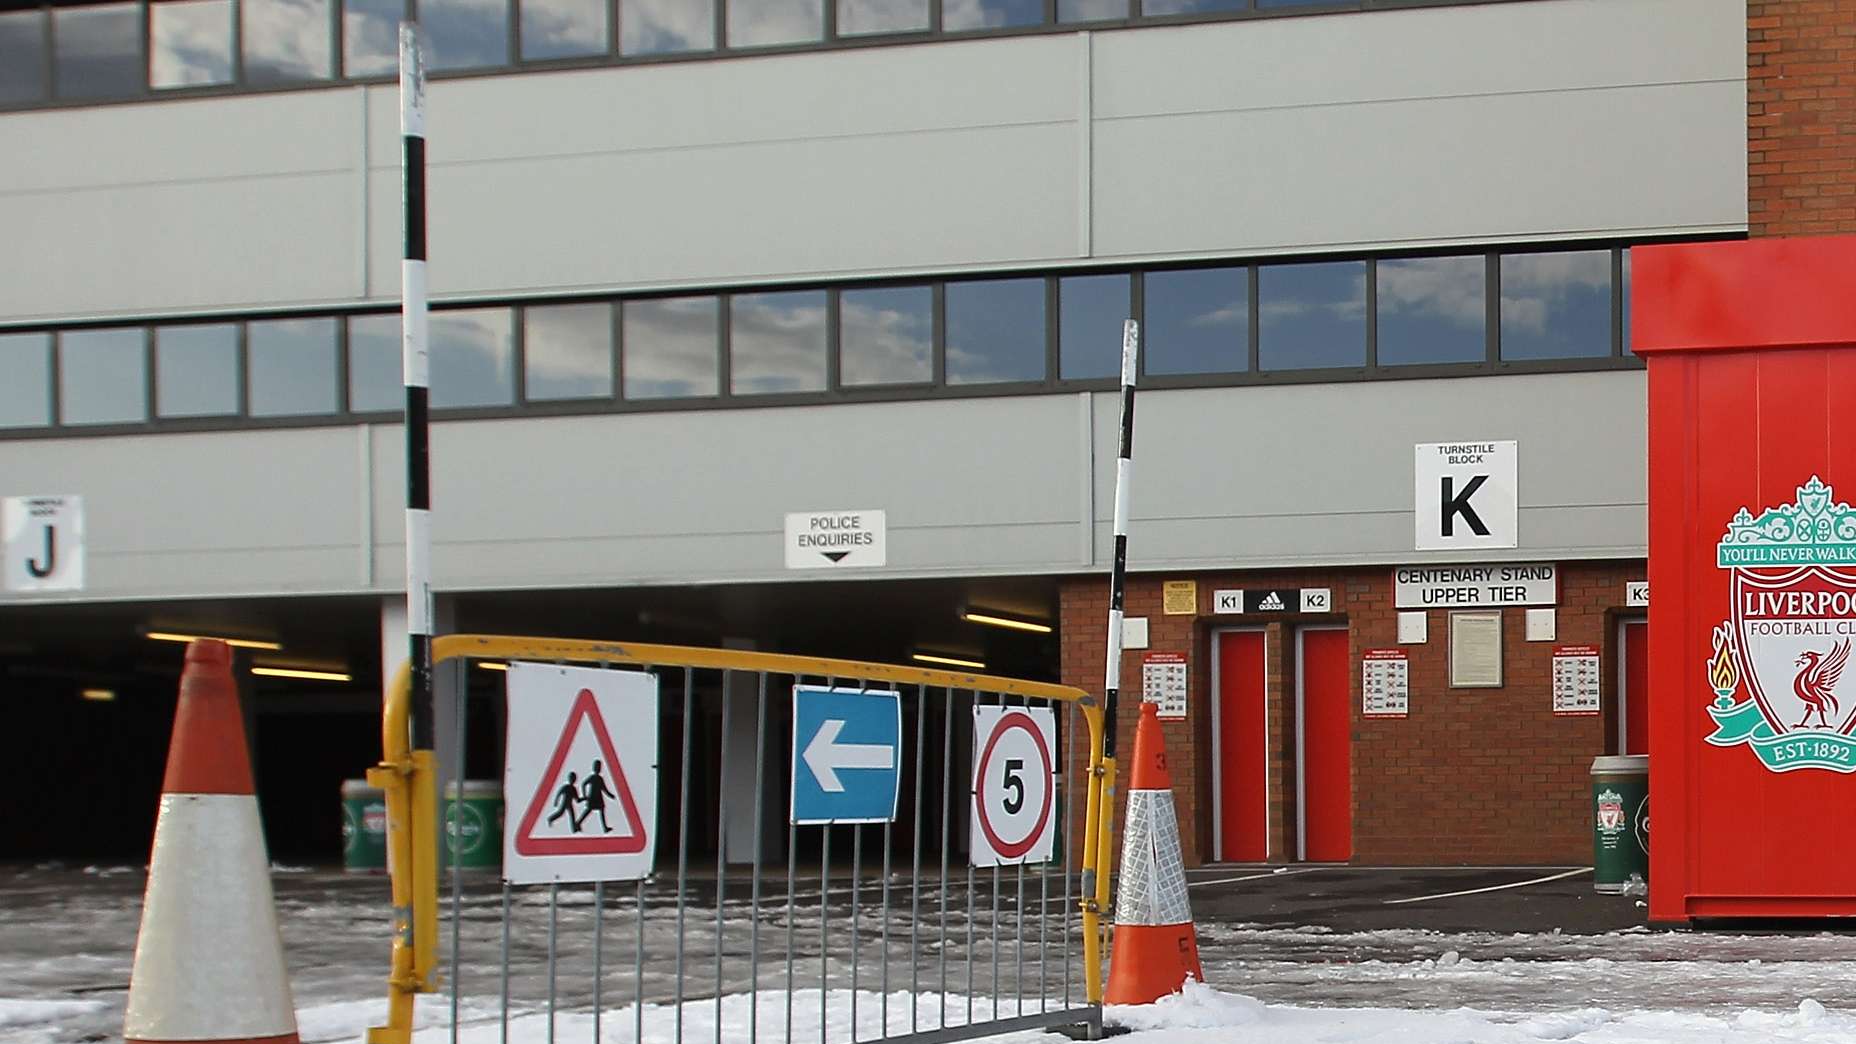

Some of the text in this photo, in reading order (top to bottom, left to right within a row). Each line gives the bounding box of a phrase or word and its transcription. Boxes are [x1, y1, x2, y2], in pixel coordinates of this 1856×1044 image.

[1438, 443, 1495, 455] TURNSTILE
[1448, 454, 1484, 465] BLOCK
[1441, 475, 1492, 537] K
[810, 515, 860, 530] POLICE
[798, 531, 873, 547] ENQUIRIES
[24, 525, 56, 578] J
[1722, 548, 1767, 562] YOU'LL
[1769, 547, 1814, 561] NEVER
[1813, 547, 1856, 561] WALK
[1397, 566, 1553, 584] CENTENARY STAND
[1221, 596, 1237, 608] K1
[1306, 595, 1324, 607] K2
[1422, 586, 1527, 604] UPPER TIER
[1751, 621, 1833, 636] FOOTBALL
[1002, 759, 1025, 815] 5
